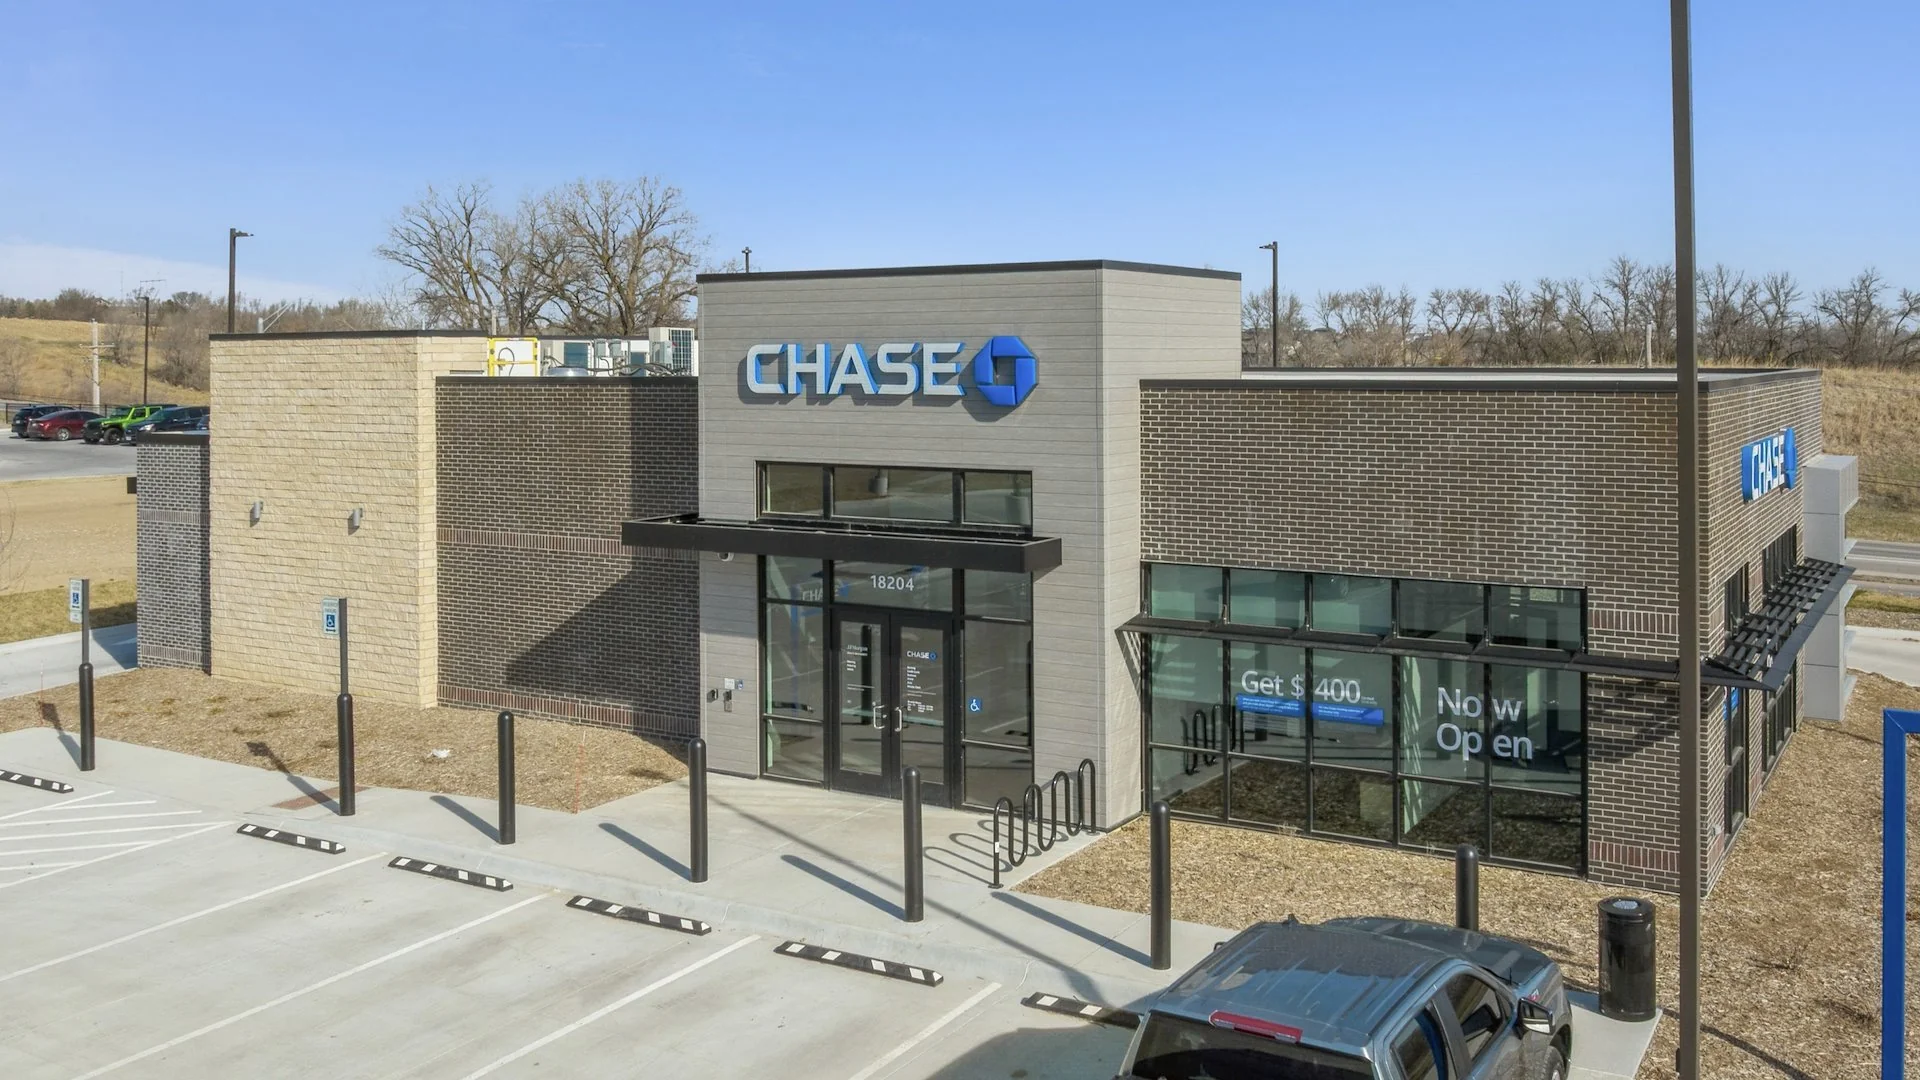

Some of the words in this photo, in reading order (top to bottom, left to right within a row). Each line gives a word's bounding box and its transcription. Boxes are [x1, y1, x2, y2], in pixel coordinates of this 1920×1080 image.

[746, 341, 965, 396] CHASE
[1750, 433, 1785, 501] CHASE
[870, 574, 915, 592] 18204
[906, 650, 930, 659] CHASE
[1241, 670, 1284, 697] Get
